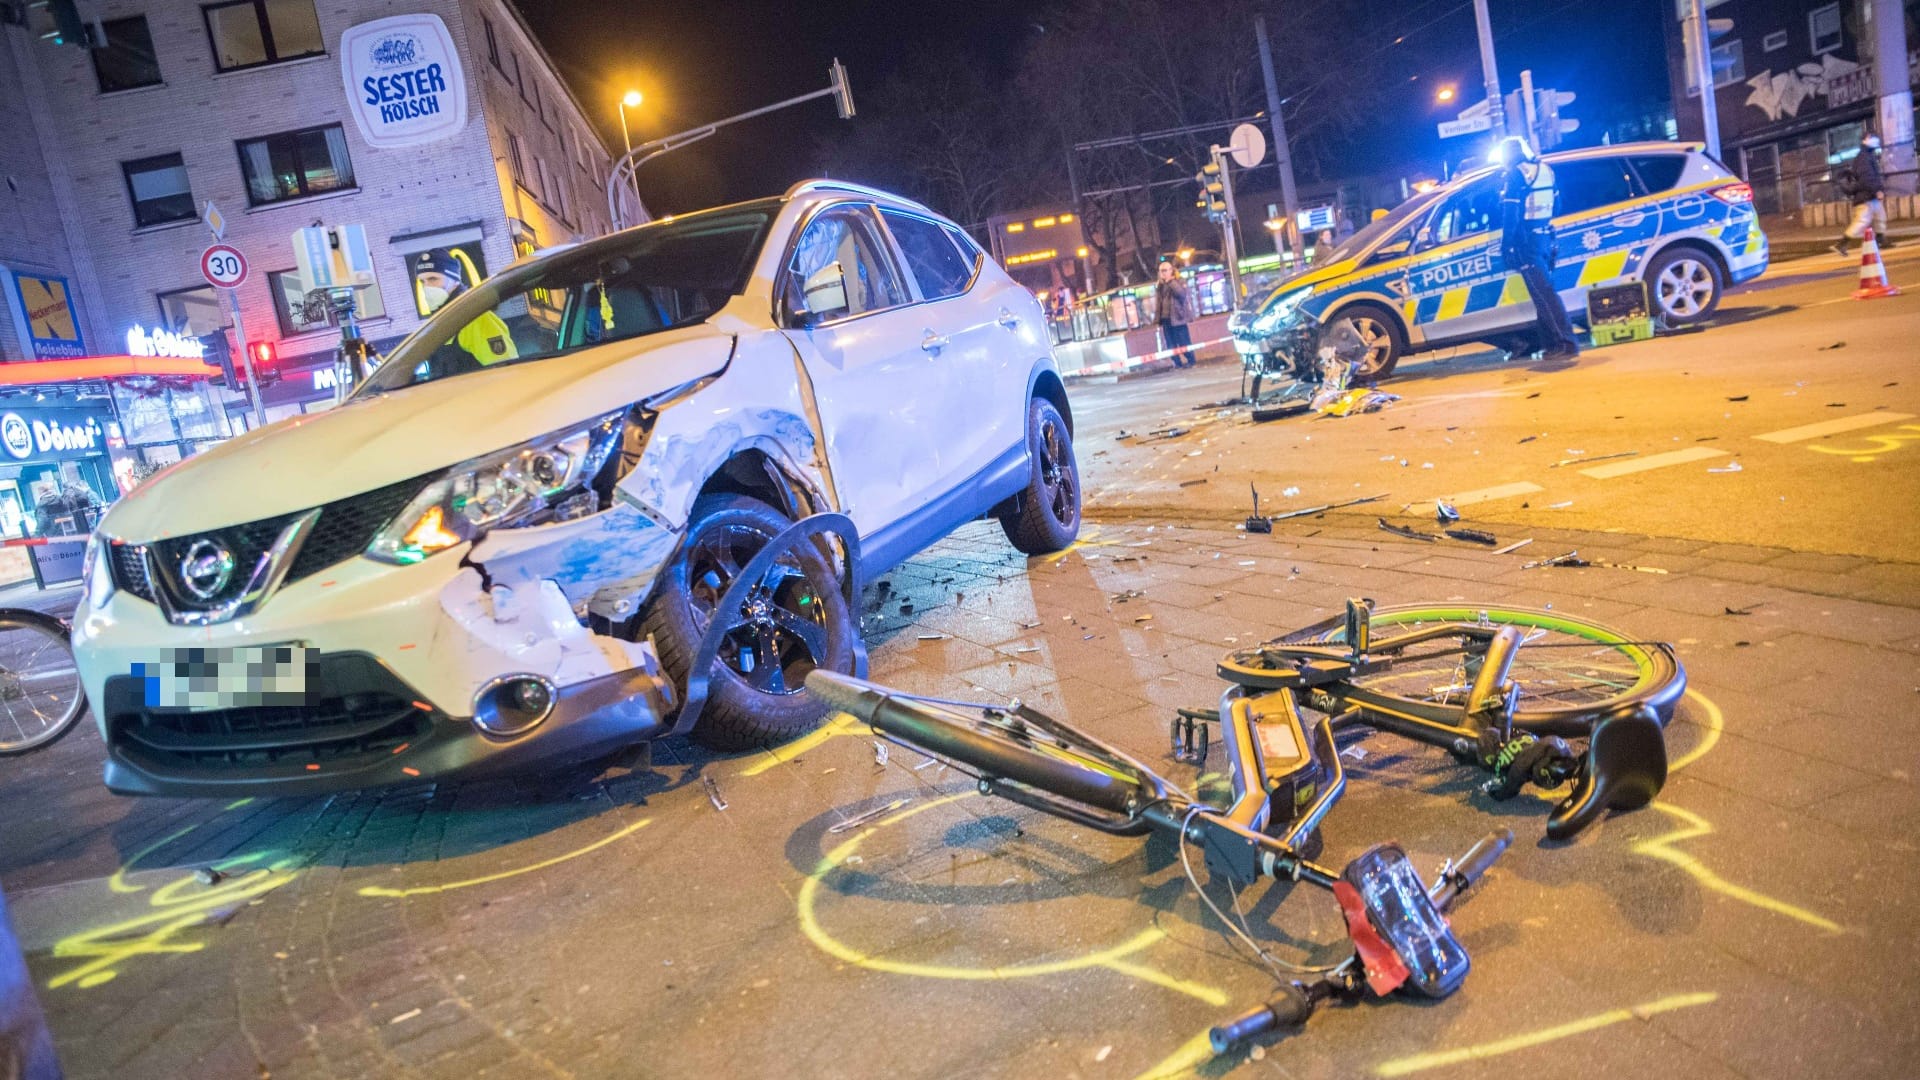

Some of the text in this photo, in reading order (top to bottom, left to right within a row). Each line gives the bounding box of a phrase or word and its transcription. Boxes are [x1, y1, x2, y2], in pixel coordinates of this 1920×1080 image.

[363, 63, 446, 106] SESTER
[380, 95, 440, 124] KÖLSCH
[211, 256, 239, 276] 30
[1422, 255, 1492, 287] POLIZEI
[35, 341, 84, 356] Reisebüro
